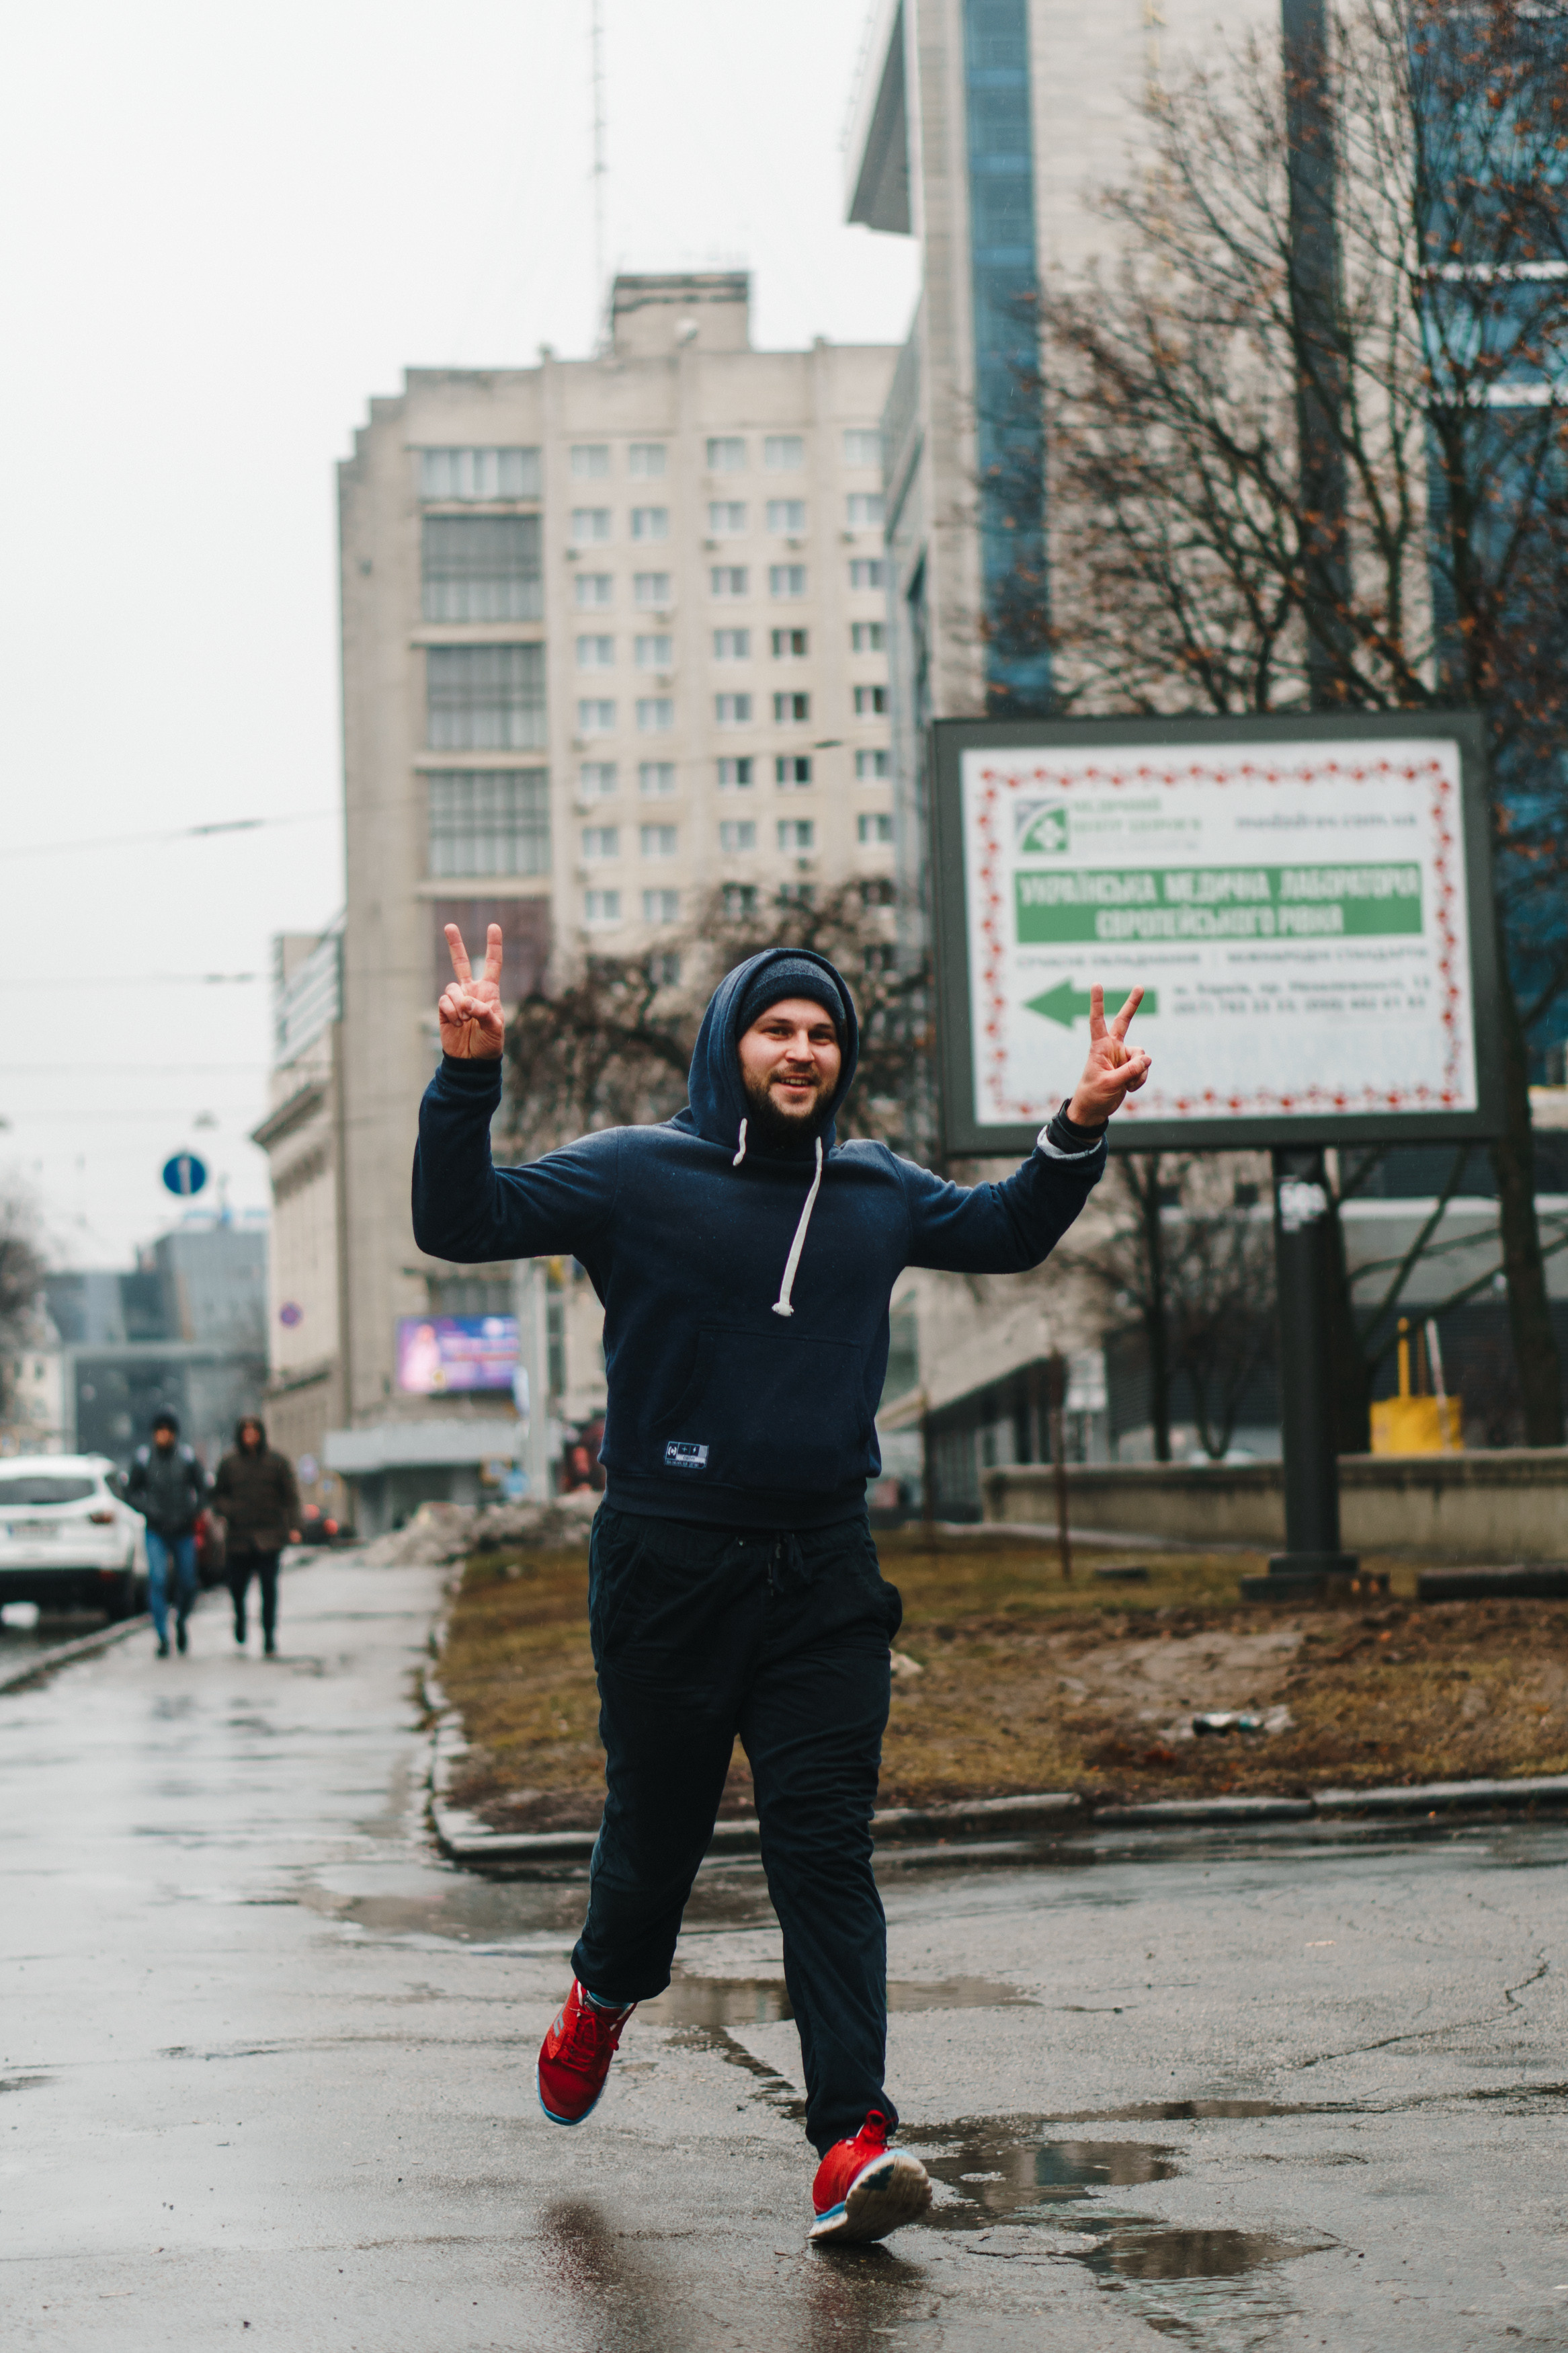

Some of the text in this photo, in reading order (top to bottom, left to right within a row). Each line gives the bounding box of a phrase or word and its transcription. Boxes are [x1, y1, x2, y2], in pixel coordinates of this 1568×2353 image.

[1020, 871, 1158, 906] УКРАЇНСЬКА
[1163, 869, 1271, 903] МЕДИЧНА
[1095, 904, 1275, 939] ЄВРОПЕЙСЬКОГО
